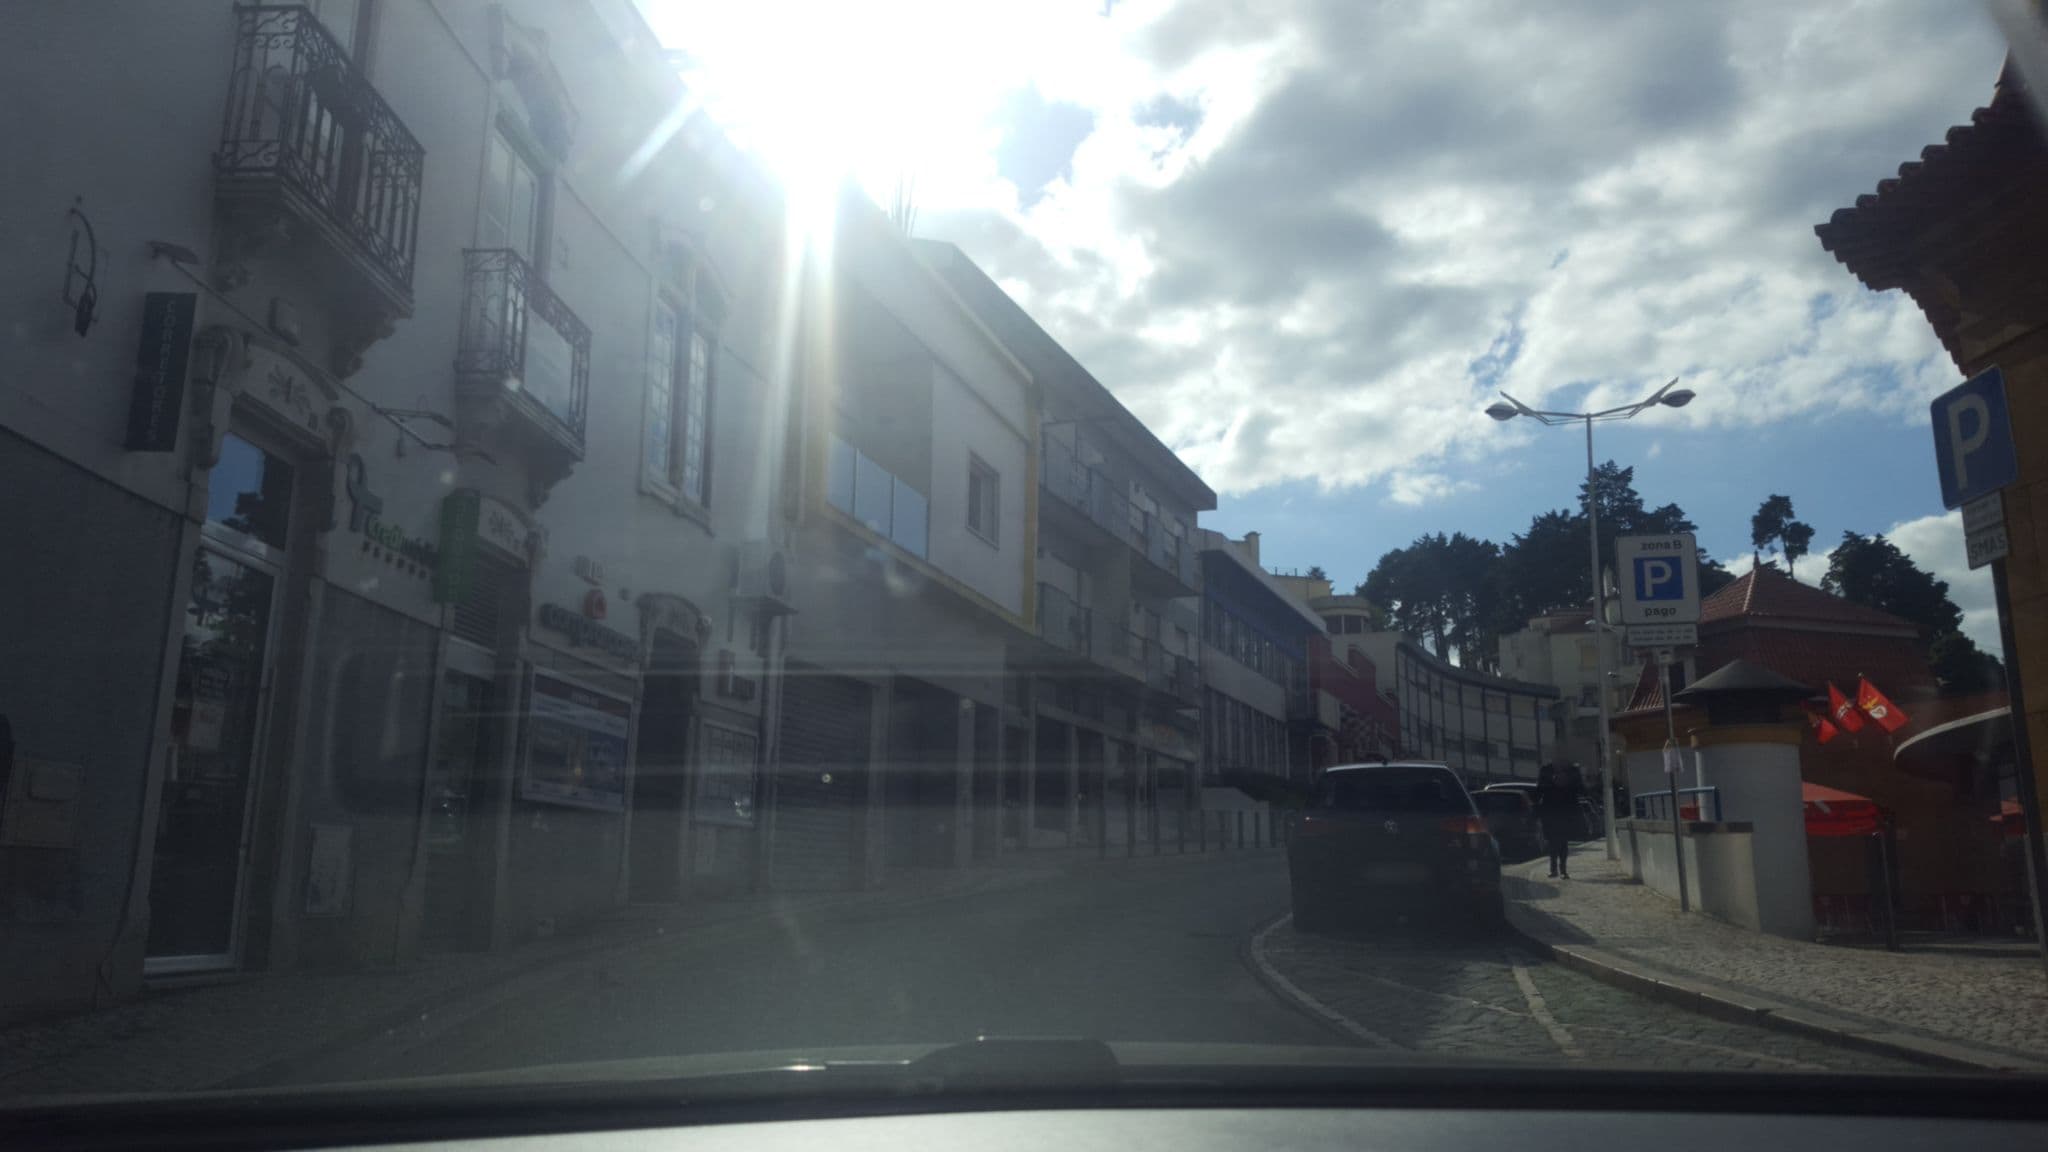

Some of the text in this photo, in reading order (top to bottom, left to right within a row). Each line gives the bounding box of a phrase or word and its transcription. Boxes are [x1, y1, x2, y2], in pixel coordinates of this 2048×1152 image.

[1947, 392, 1991, 491] P
[1641, 540, 1682, 550] zona B
[1643, 560, 1673, 597] P
[1645, 607, 1676, 617] pago
